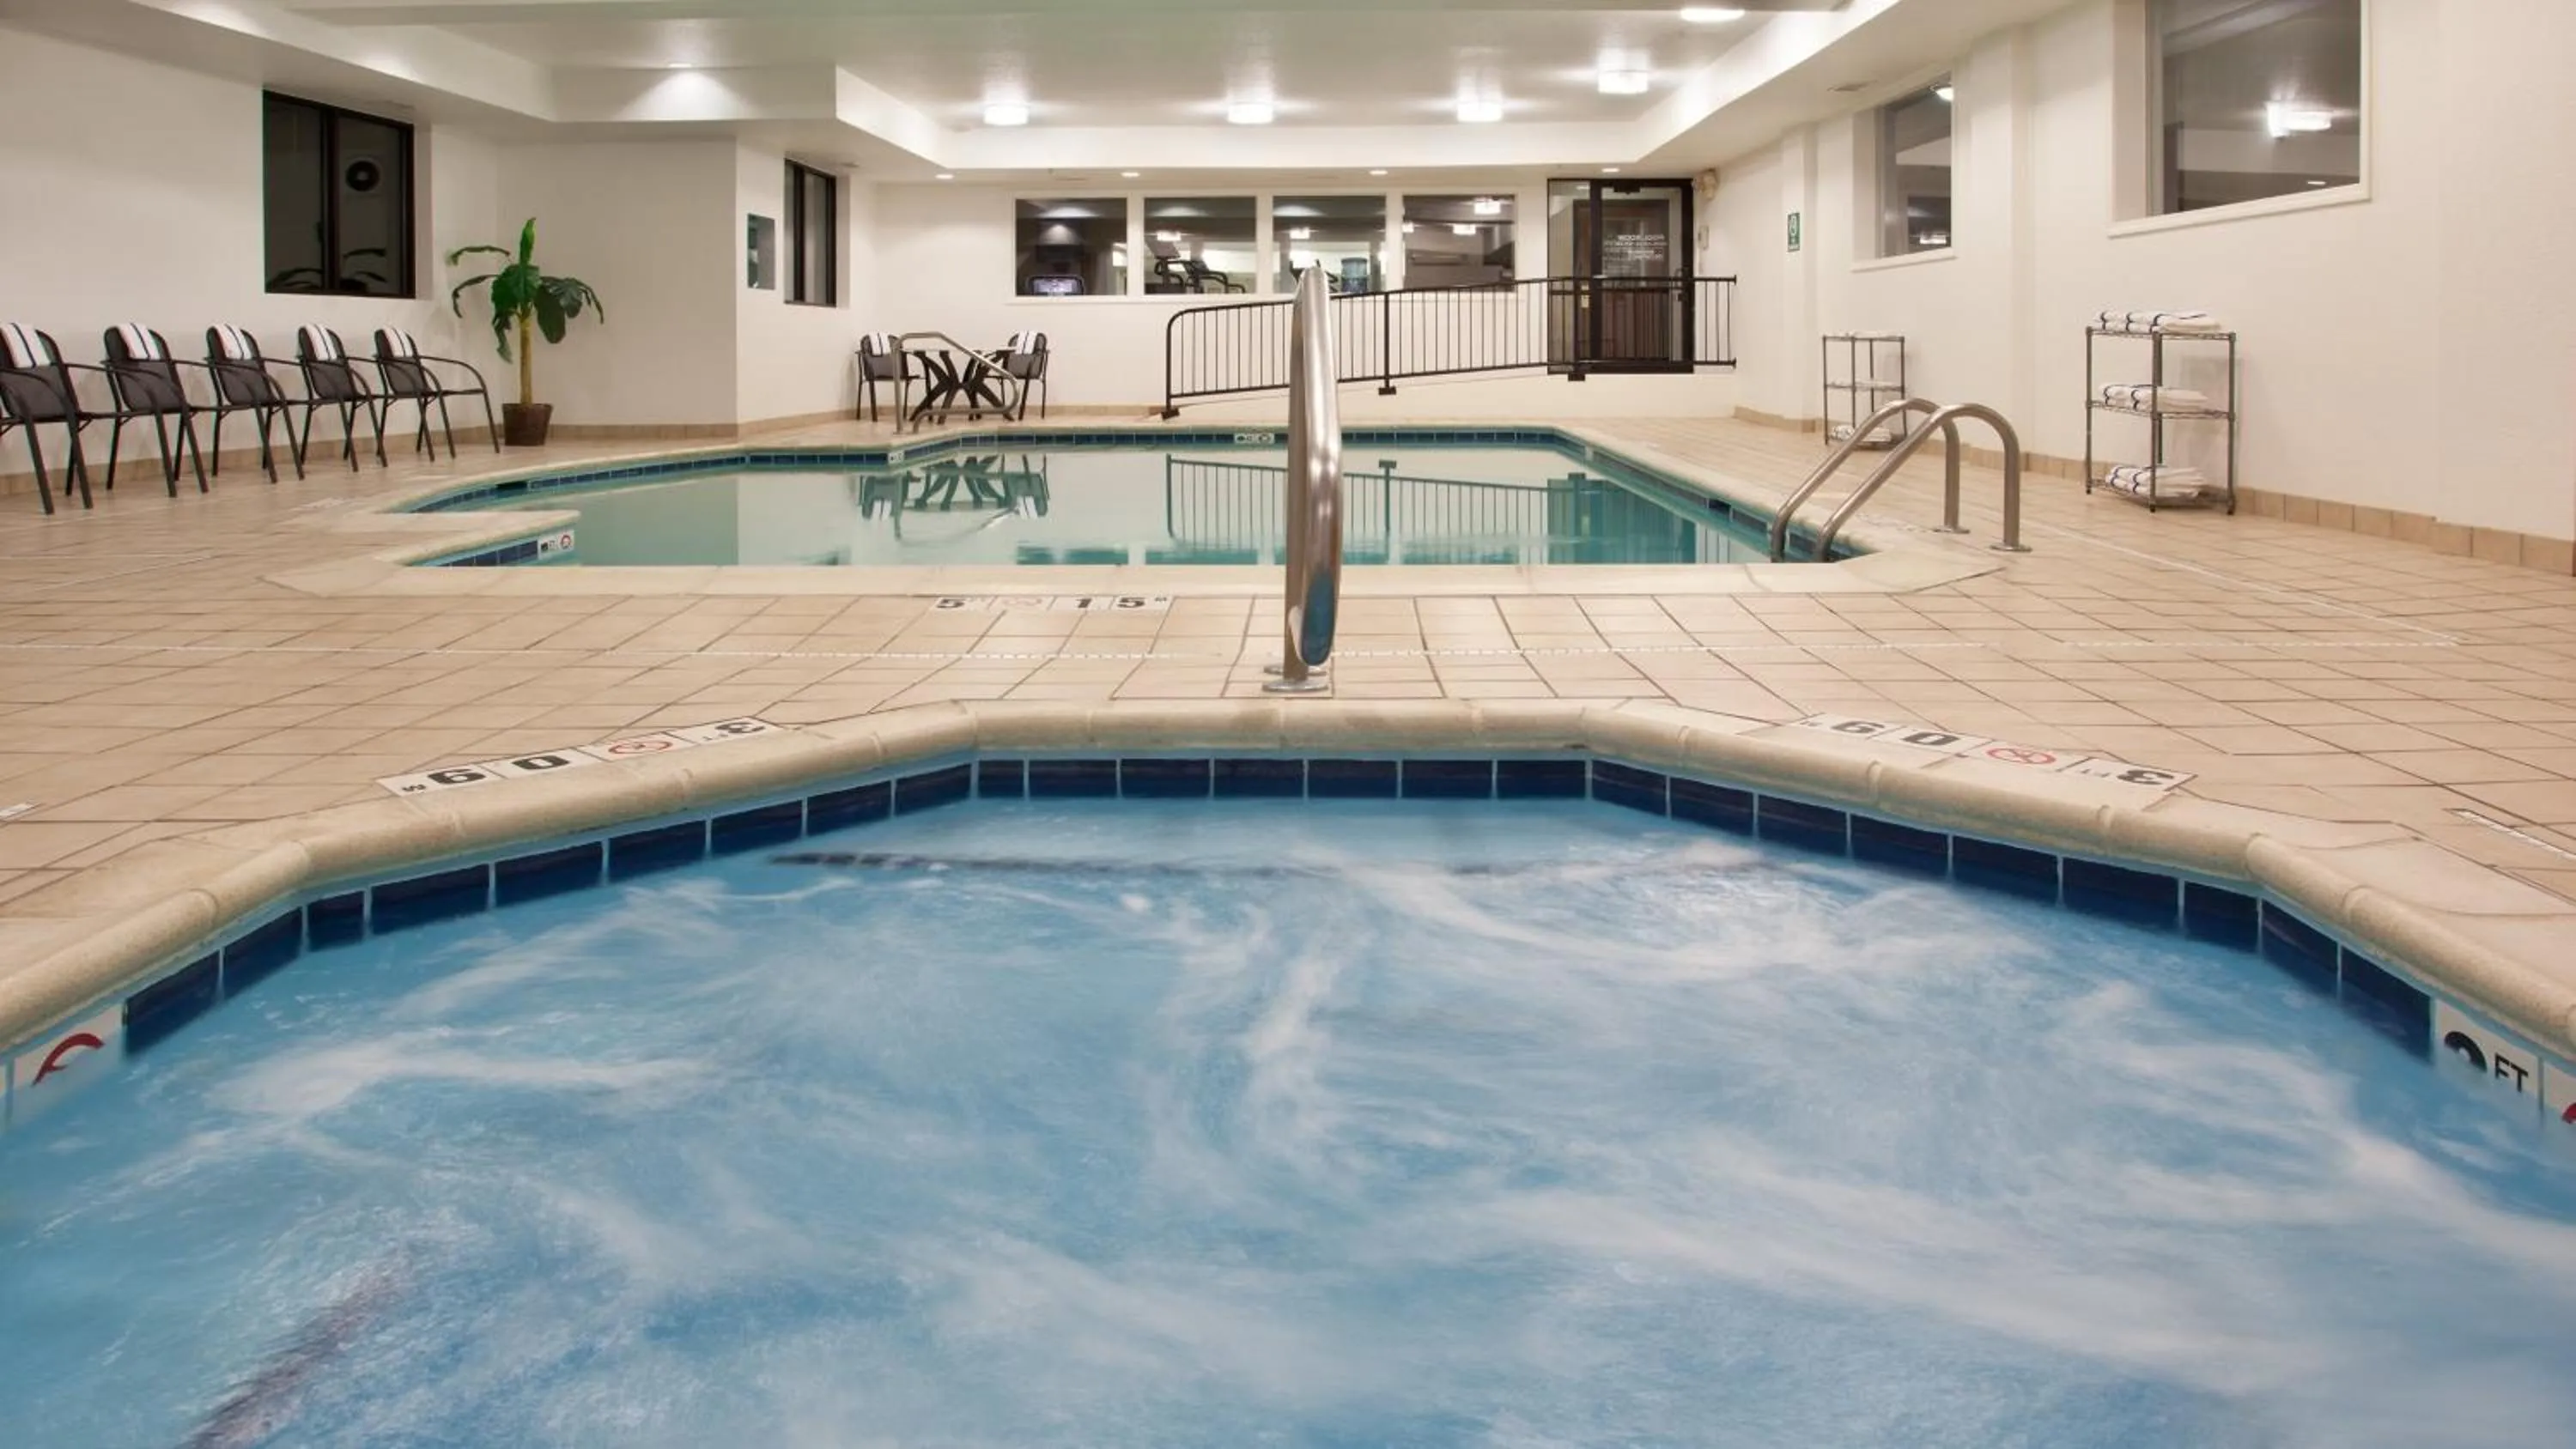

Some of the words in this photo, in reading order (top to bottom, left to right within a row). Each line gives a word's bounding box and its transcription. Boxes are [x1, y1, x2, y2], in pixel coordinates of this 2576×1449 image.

[936, 597, 965, 609] 5
[1117, 597, 1145, 609] 5
[1900, 731, 1960, 745] 0
[512, 755, 570, 770] 0
[2494, 1052, 2529, 1093] FT
